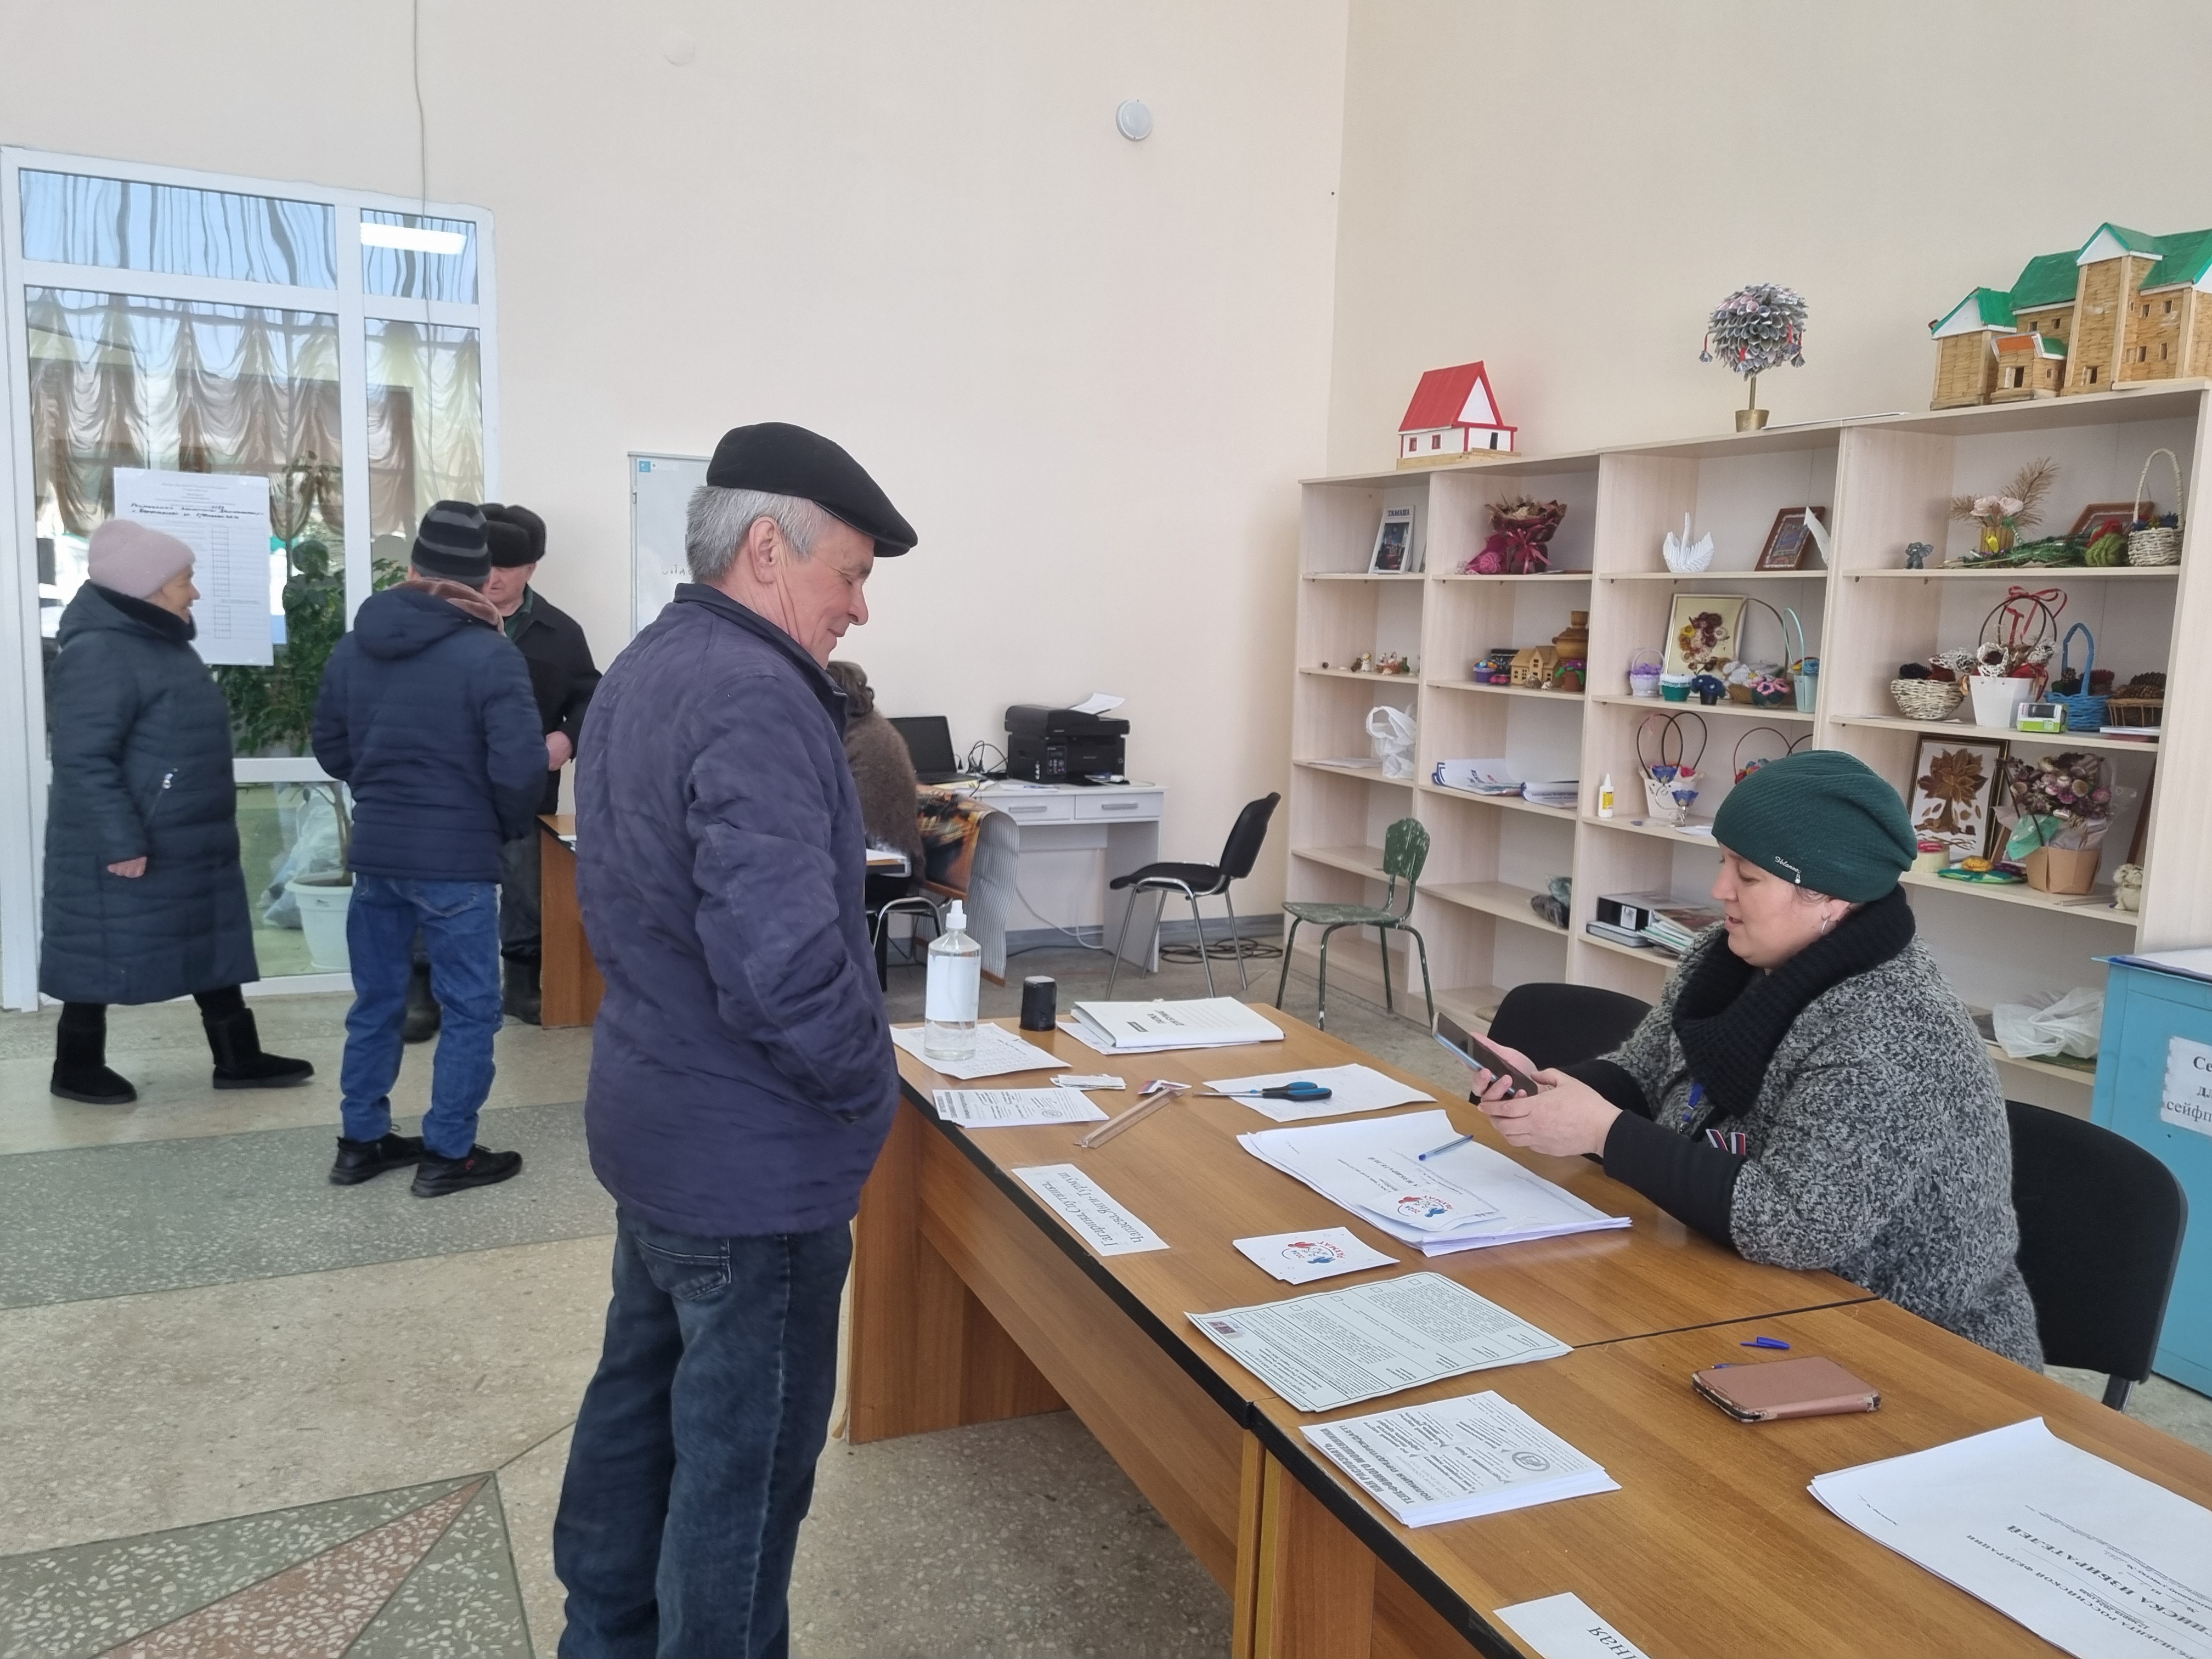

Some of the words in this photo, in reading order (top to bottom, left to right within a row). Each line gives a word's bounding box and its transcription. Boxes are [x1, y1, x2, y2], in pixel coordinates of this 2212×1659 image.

[1319, 1428, 1366, 1463] МОШЕННИКА
[1321, 1443, 1370, 1480] РАСПОЗНАТЬ
[1361, 1463, 1415, 1504] ТЕЛЕФОННОГО
[1395, 1472, 1435, 1500] ПОЛИЦИЯ
[1966, 1534, 2034, 1572] ФЕДЕРАЦИИ
[2005, 1525, 2135, 1595] ИЗБИРАТЕЛЕЙ
[2035, 1571, 2118, 1621] РОССИЙСКОЙ
